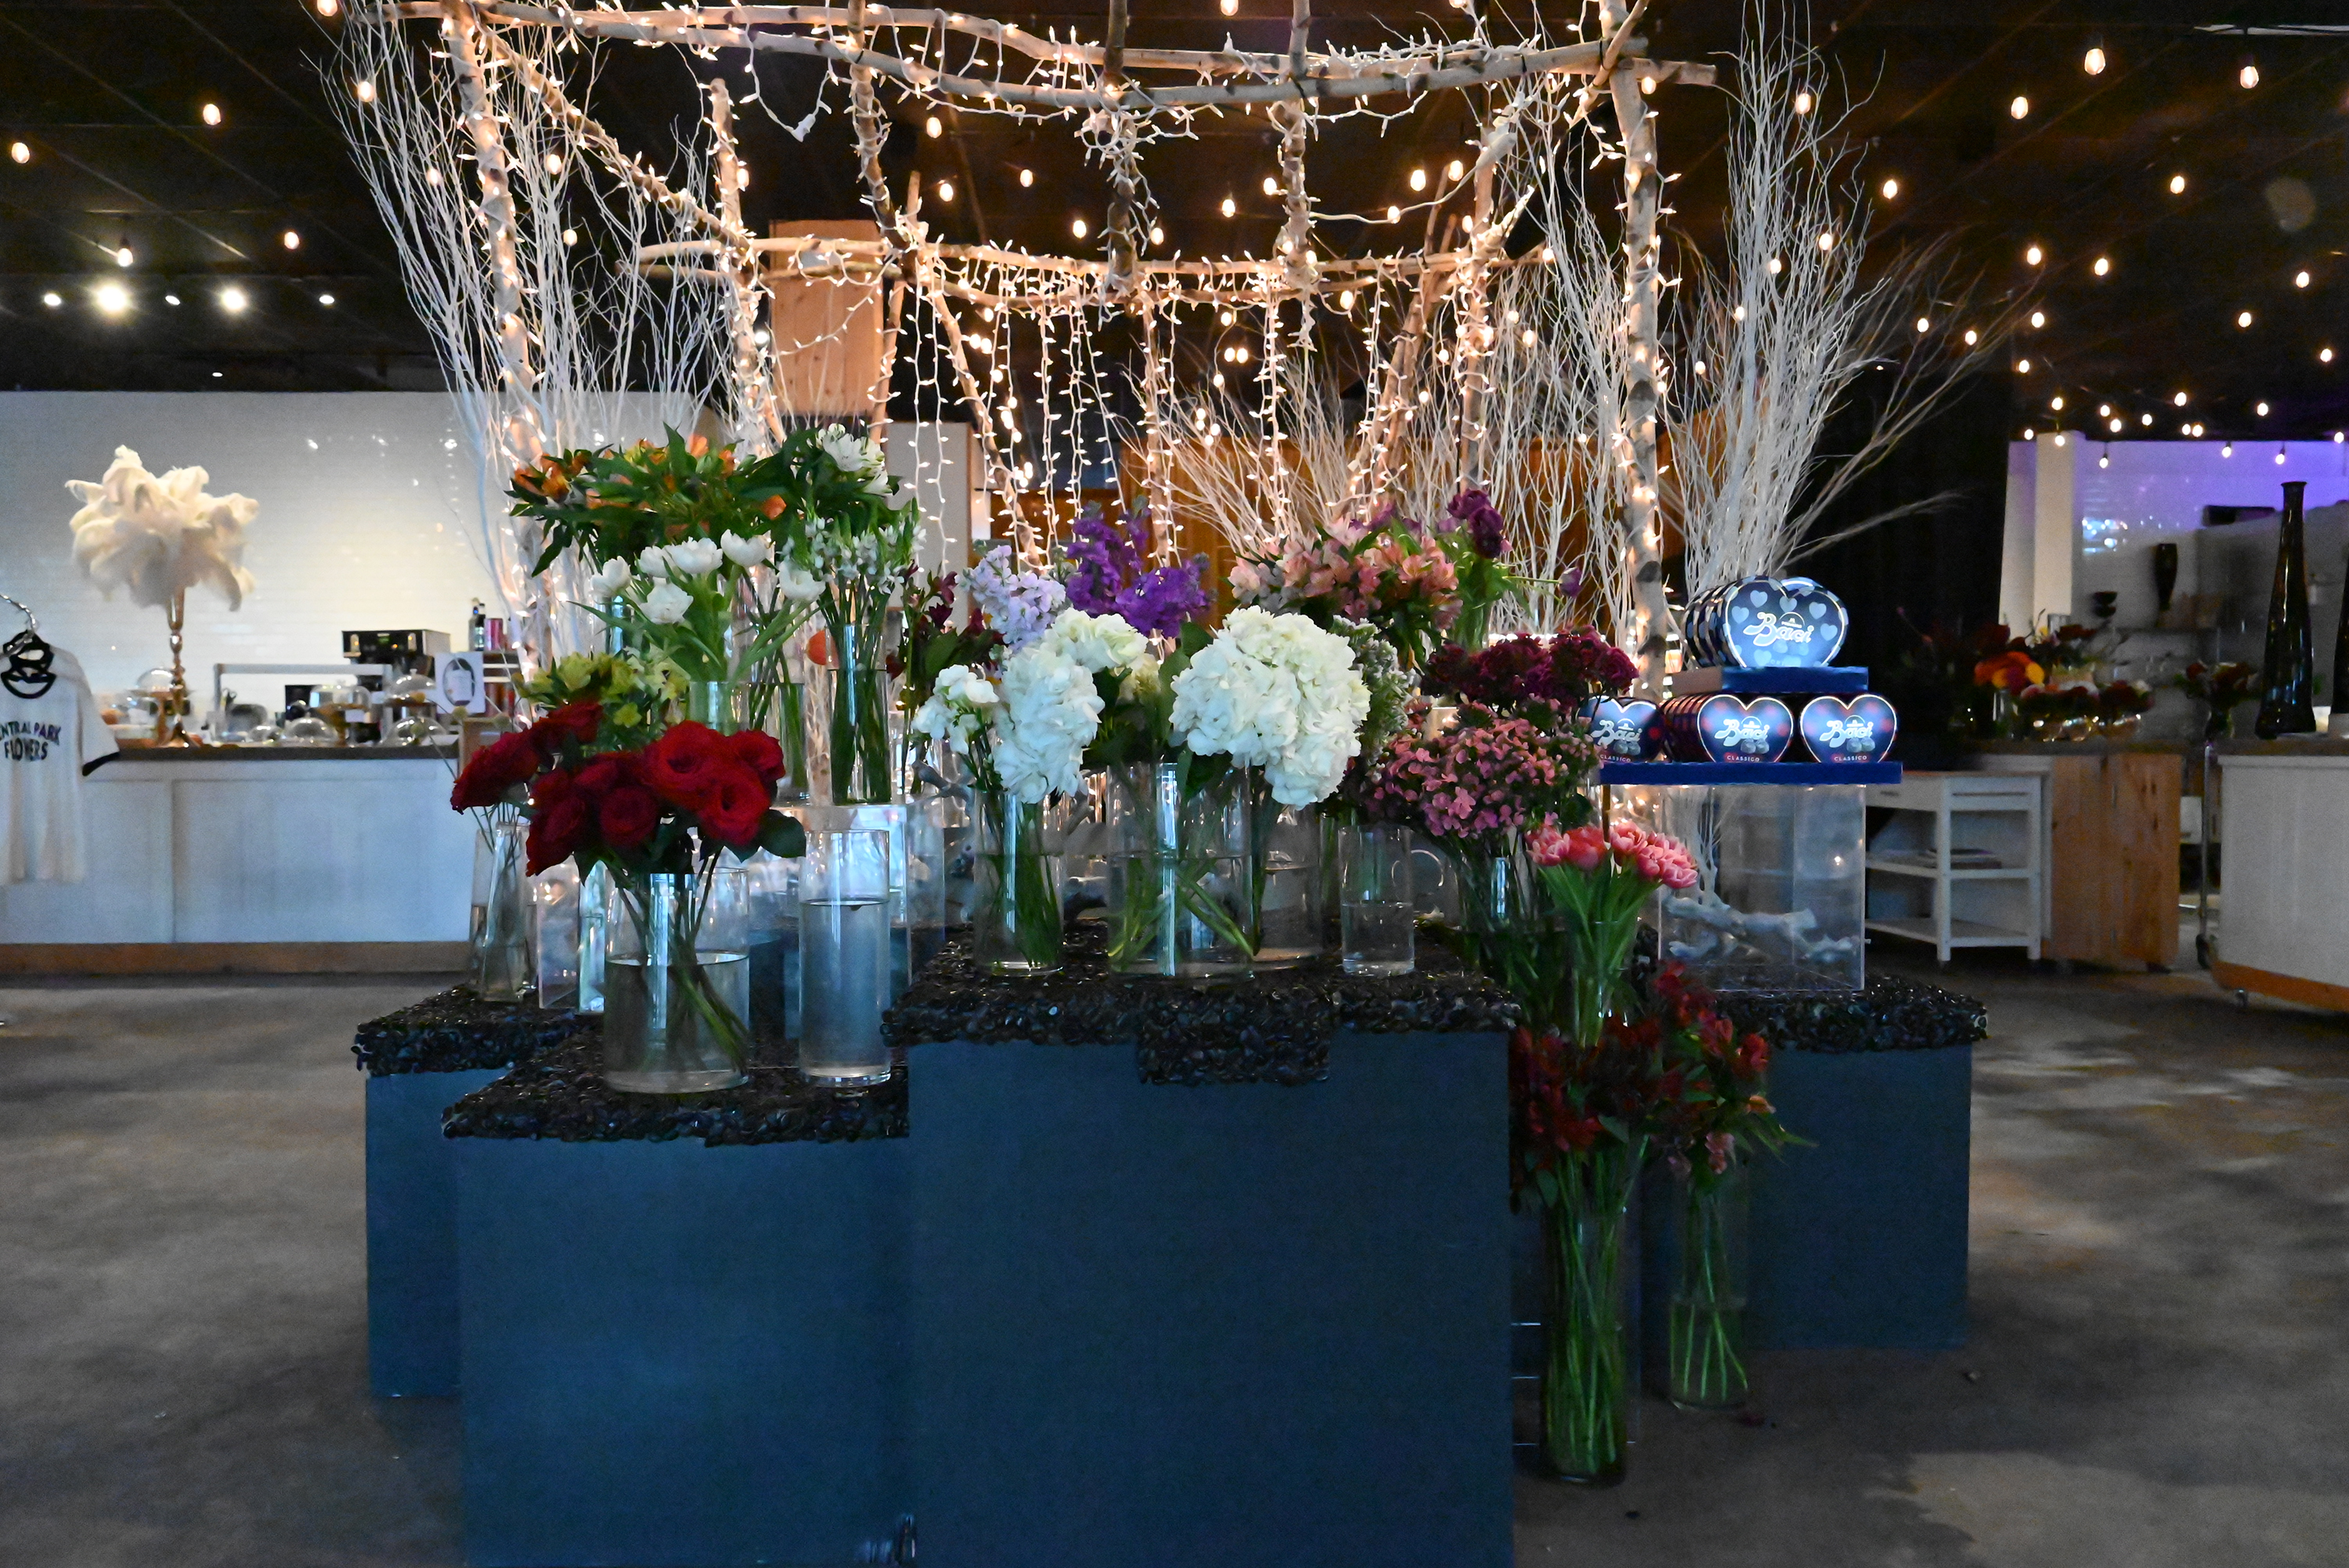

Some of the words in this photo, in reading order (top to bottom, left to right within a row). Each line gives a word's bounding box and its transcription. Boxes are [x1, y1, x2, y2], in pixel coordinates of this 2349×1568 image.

[1743, 611, 1814, 647] Baci
[34, 722, 61, 745] PARK
[1590, 719, 1643, 747] Baci
[1714, 719, 1770, 747] Baci
[1819, 719, 1874, 748] Baci
[1600, 754, 1631, 762] CLASSICO
